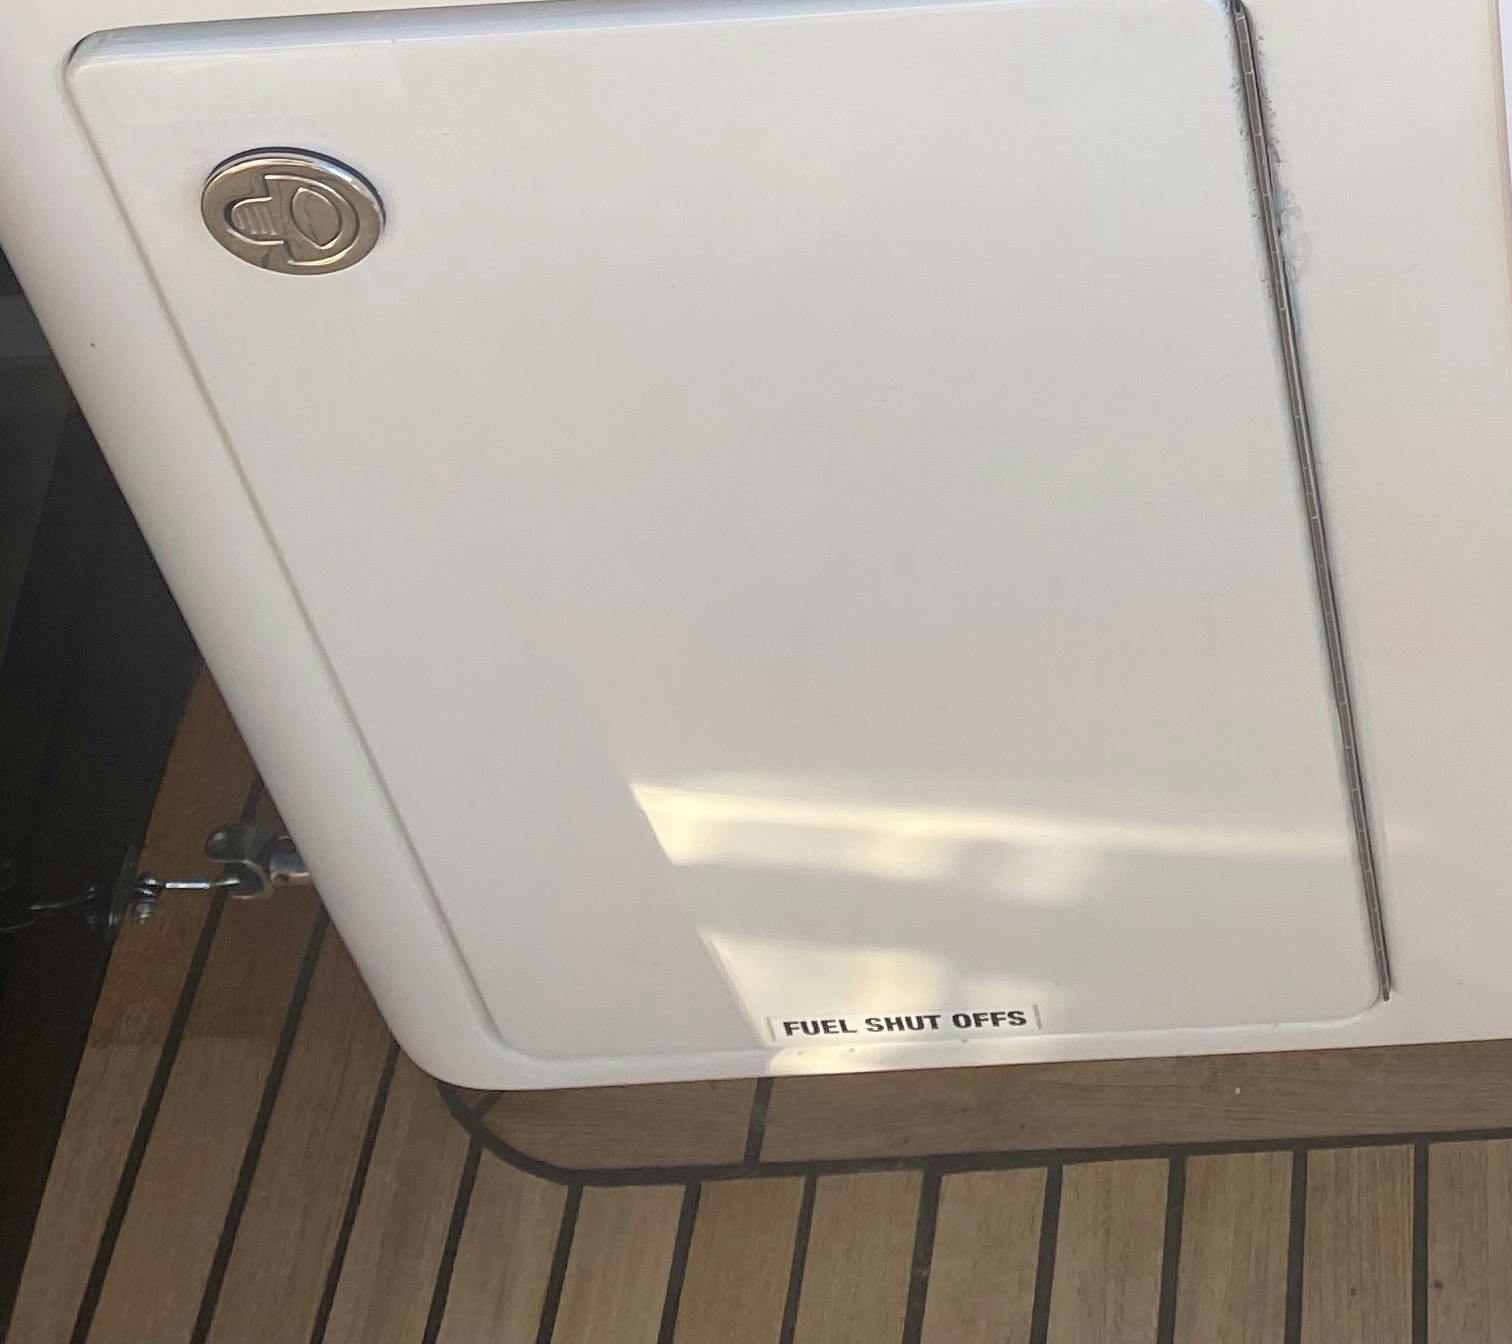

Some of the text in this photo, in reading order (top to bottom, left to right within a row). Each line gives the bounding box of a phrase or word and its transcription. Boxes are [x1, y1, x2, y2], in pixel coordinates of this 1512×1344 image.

[783, 1010, 1027, 1036] FUEL SHUT OFFS
